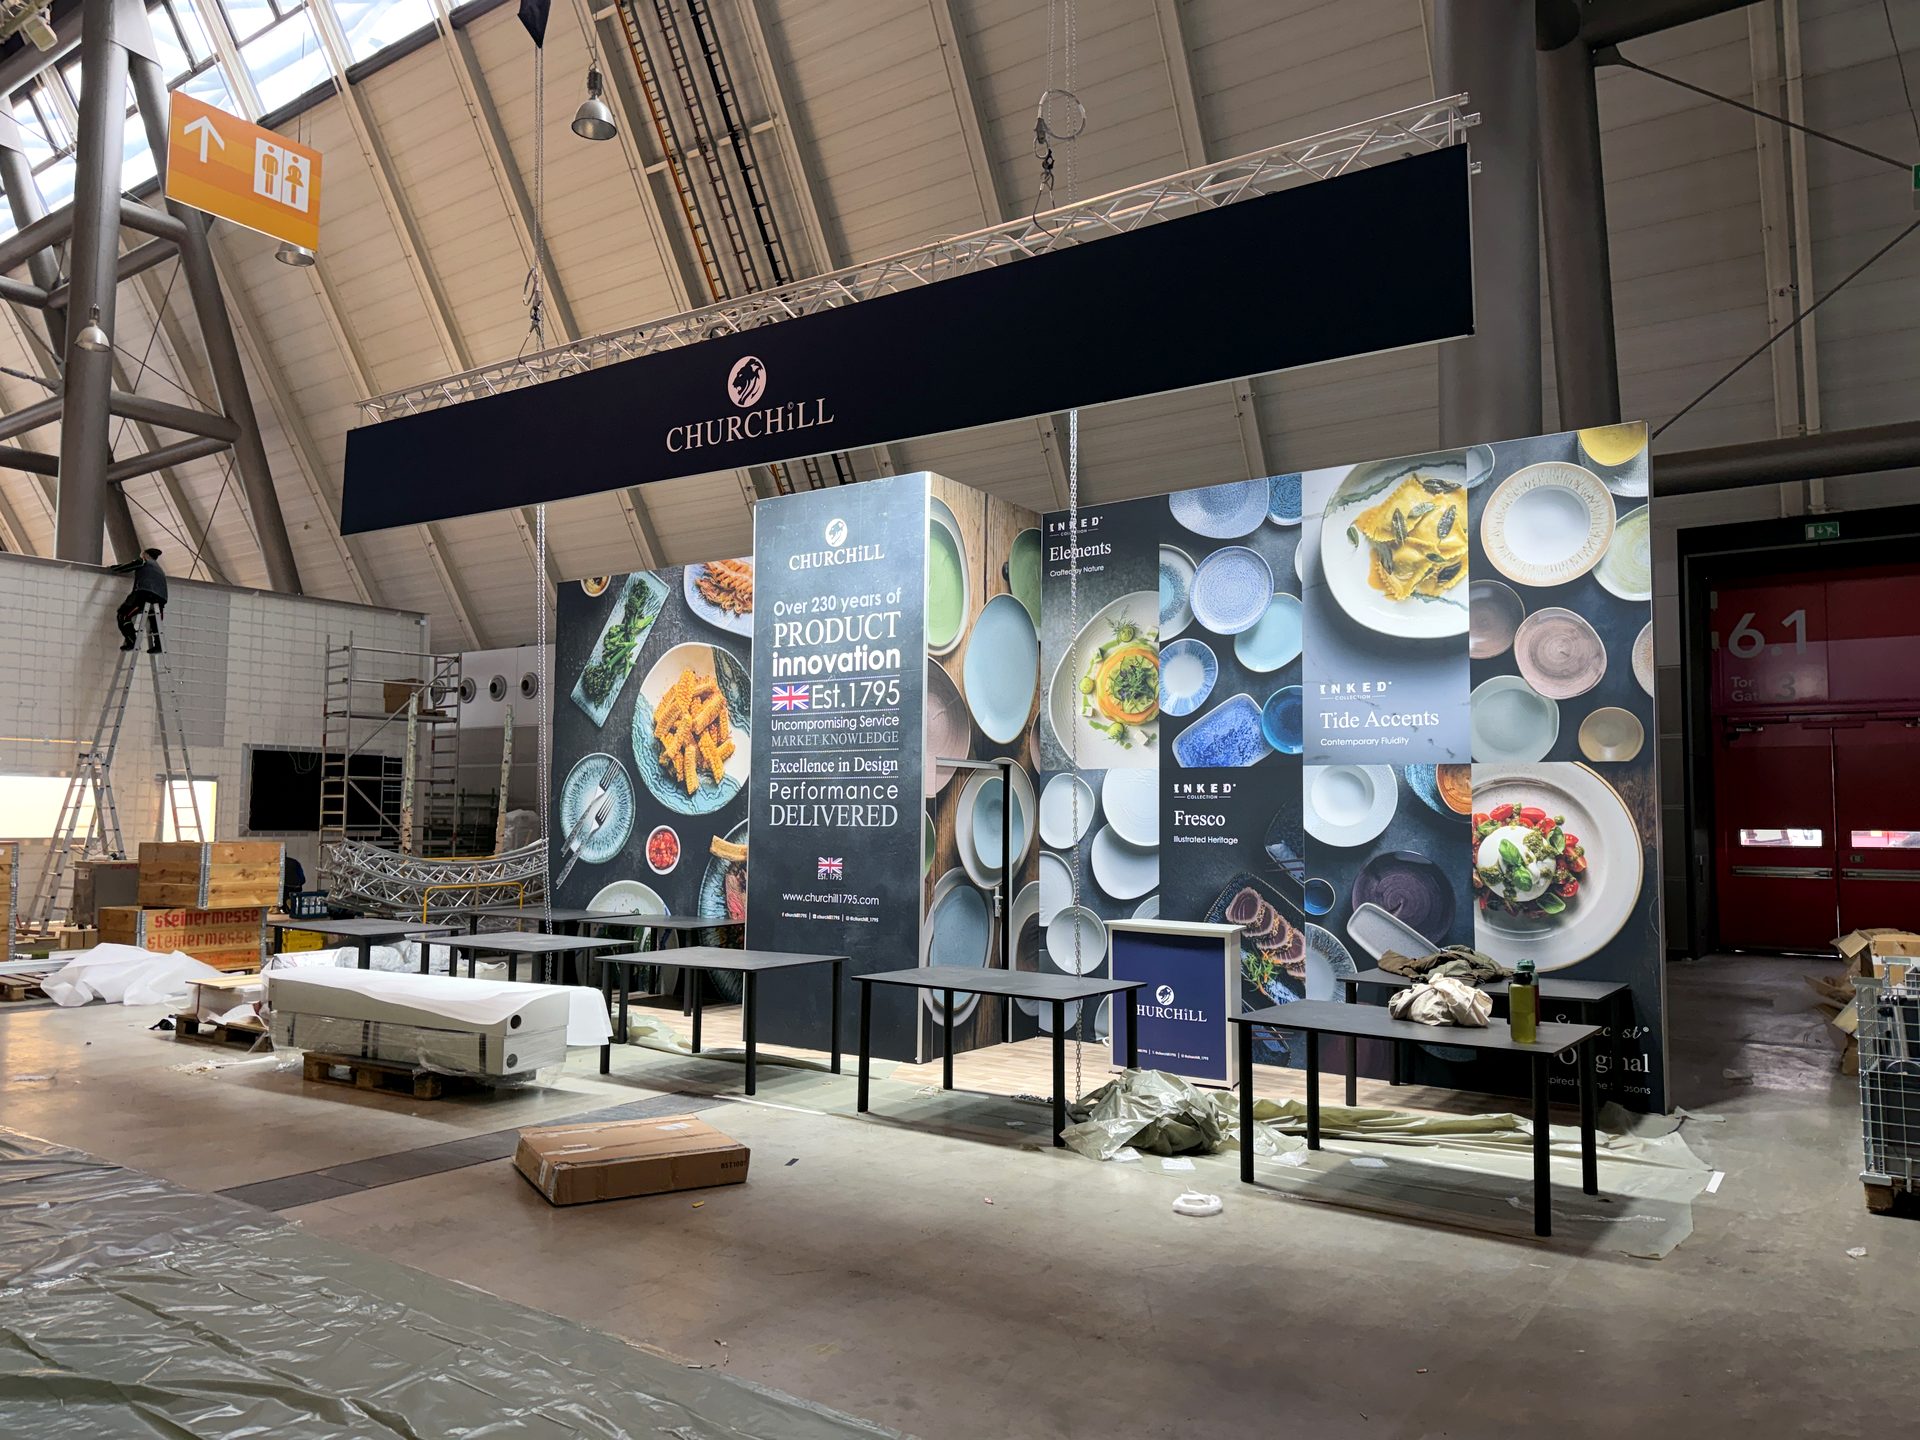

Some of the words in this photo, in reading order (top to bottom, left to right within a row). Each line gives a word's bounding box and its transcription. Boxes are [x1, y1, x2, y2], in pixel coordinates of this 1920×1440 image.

[1049, 542, 1111, 561] Elements
[1083, 565, 1104, 573] Nature
[774, 600, 808, 616] Over
[811, 595, 836, 612] 230
[841, 593, 881, 613] years
[886, 587, 901, 604] of
[773, 611, 901, 648] PRODUCT
[1728, 609, 1807, 659] 6.1
[772, 644, 901, 677] innovation
[1320, 681, 1387, 695] INKED
[1731, 676, 1756, 688] Tor
[1775, 672, 1796, 700] 3
[1731, 690, 1762, 702] Gat
[771, 716, 857, 732] Uncompromising
[859, 714, 899, 728] Service
[1320, 711, 1360, 729] Tide
[1364, 710, 1440, 728] Accents
[771, 733, 819, 747] MARKET
[822, 731, 899, 746] KNOWLEDGE
[1320, 738, 1379, 747] Contemporary
[1381, 736, 1410, 745] Fluidity
[770, 757, 835, 773] Excellence
[838, 756, 850, 772] in
[854, 755, 899, 775] Design
[769, 782, 899, 800] Performance
[1173, 783, 1232, 794] INKED
[769, 804, 899, 827] DELIVERED
[1173, 810, 1226, 826] Fresco
[1173, 835, 1206, 843] Illustrated
[1207, 835, 1239, 845] Heritage
[782, 891, 880, 905] www.churchill1795.com
[155, 908, 259, 929] steinermesse
[147, 931, 252, 950] steinermesse
[1136, 1004, 1208, 1022] HURCHiLL
